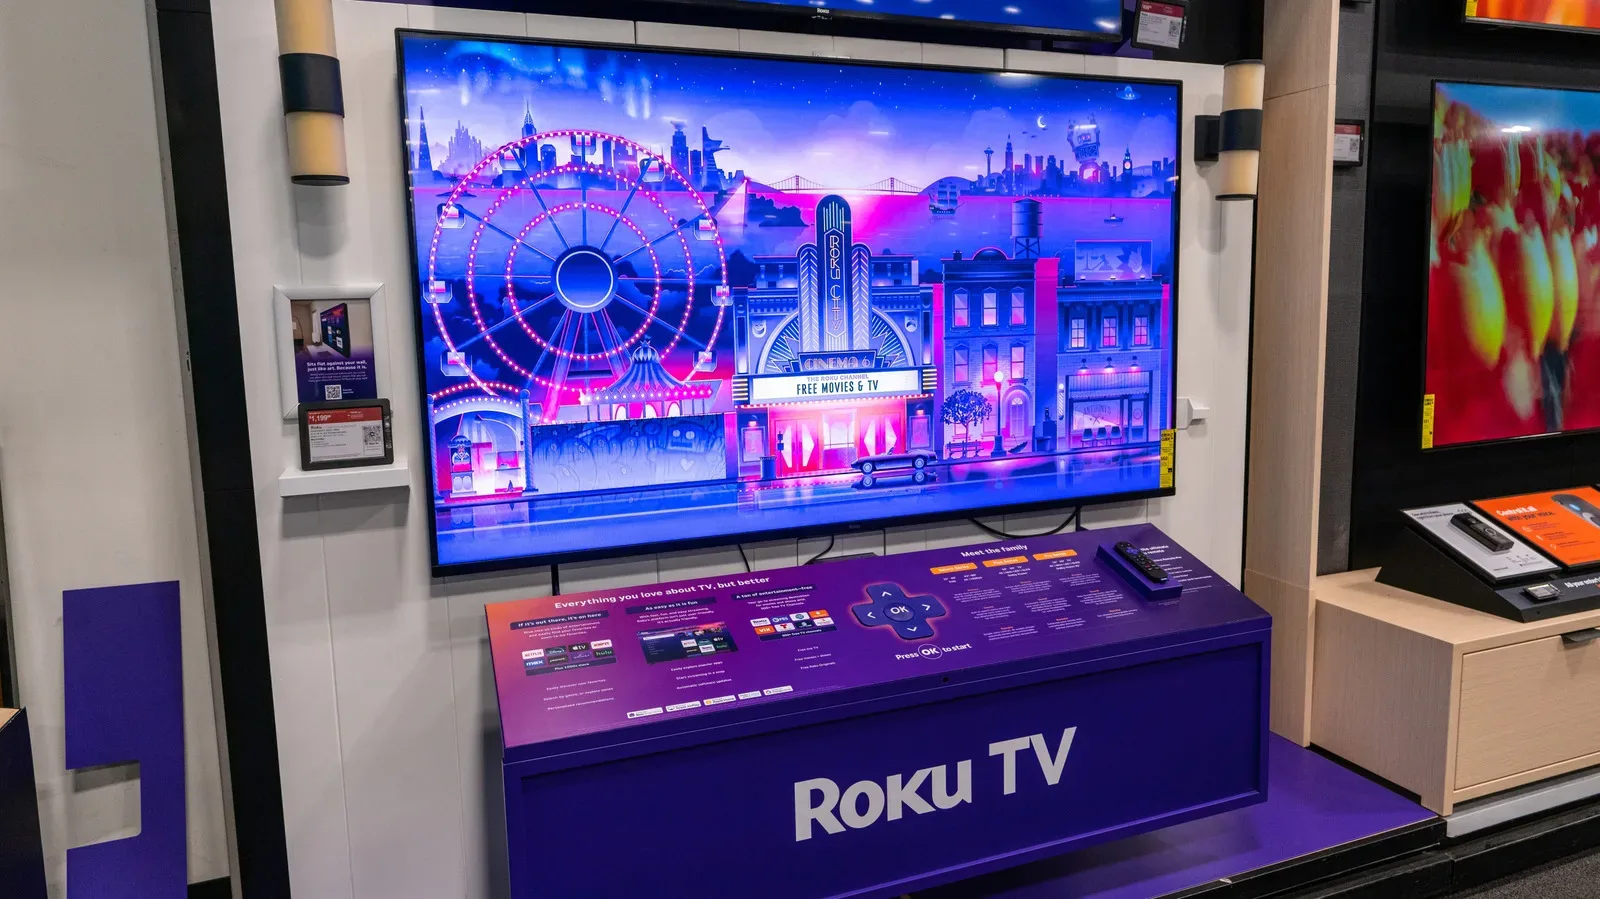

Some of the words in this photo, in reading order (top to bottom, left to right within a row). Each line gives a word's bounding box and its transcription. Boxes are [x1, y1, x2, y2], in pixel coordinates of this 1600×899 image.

[829, 235, 841, 280] ROKU
[830, 285, 842, 331] CITY
[804, 356, 859, 370] CINEMA
[861, 356, 871, 368] 6
[796, 383, 818, 395] FREE
[822, 380, 854, 394] MOVIES
[858, 380, 864, 392] &
[868, 380, 879, 391] TV
[1001, 544, 1028, 552] family
[554, 596, 617, 609] Everything
[618, 592, 639, 603] you
[640, 590, 664, 598] love
[666, 586, 697, 596] about
[698, 584, 716, 592] TV,
[717, 580, 736, 588] but
[737, 577, 770, 586] better
[890, 606, 910, 614] OK
[895, 651, 920, 660] Press
[921, 647, 940, 656] OK
[952, 643, 972, 651] start
[794, 759, 972, 842] Roku
[988, 726, 1078, 796] TV
